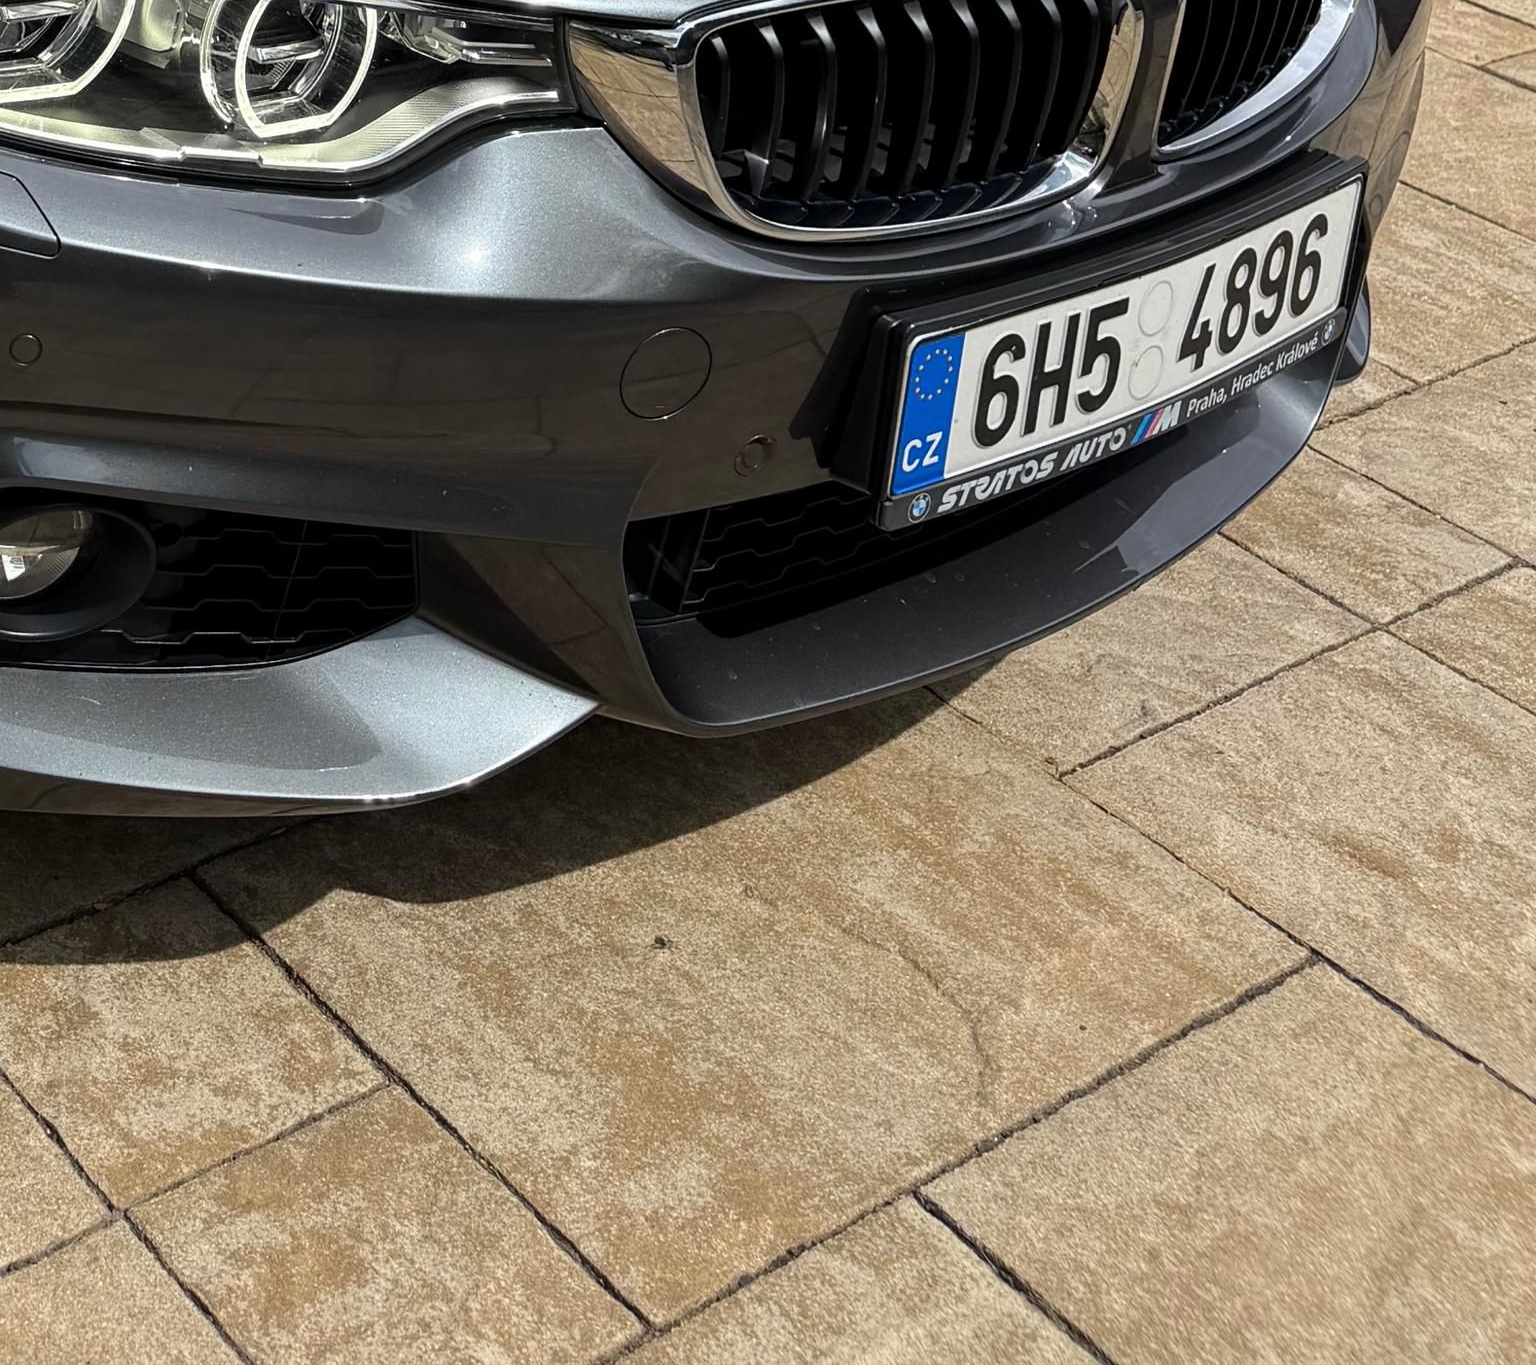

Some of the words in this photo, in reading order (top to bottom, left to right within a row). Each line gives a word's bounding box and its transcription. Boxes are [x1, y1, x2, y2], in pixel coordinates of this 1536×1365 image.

[973, 297, 1129, 448] 6H5
[1177, 212, 1328, 372] 4896
[902, 431, 943, 473] CZ
[936, 451, 1059, 513] STRATOS
[1059, 427, 1127, 471] AUTO
[1186, 387, 1228, 418] Praha,
[1230, 359, 1274, 396] Hradec
[1275, 331, 1319, 372] Králové
